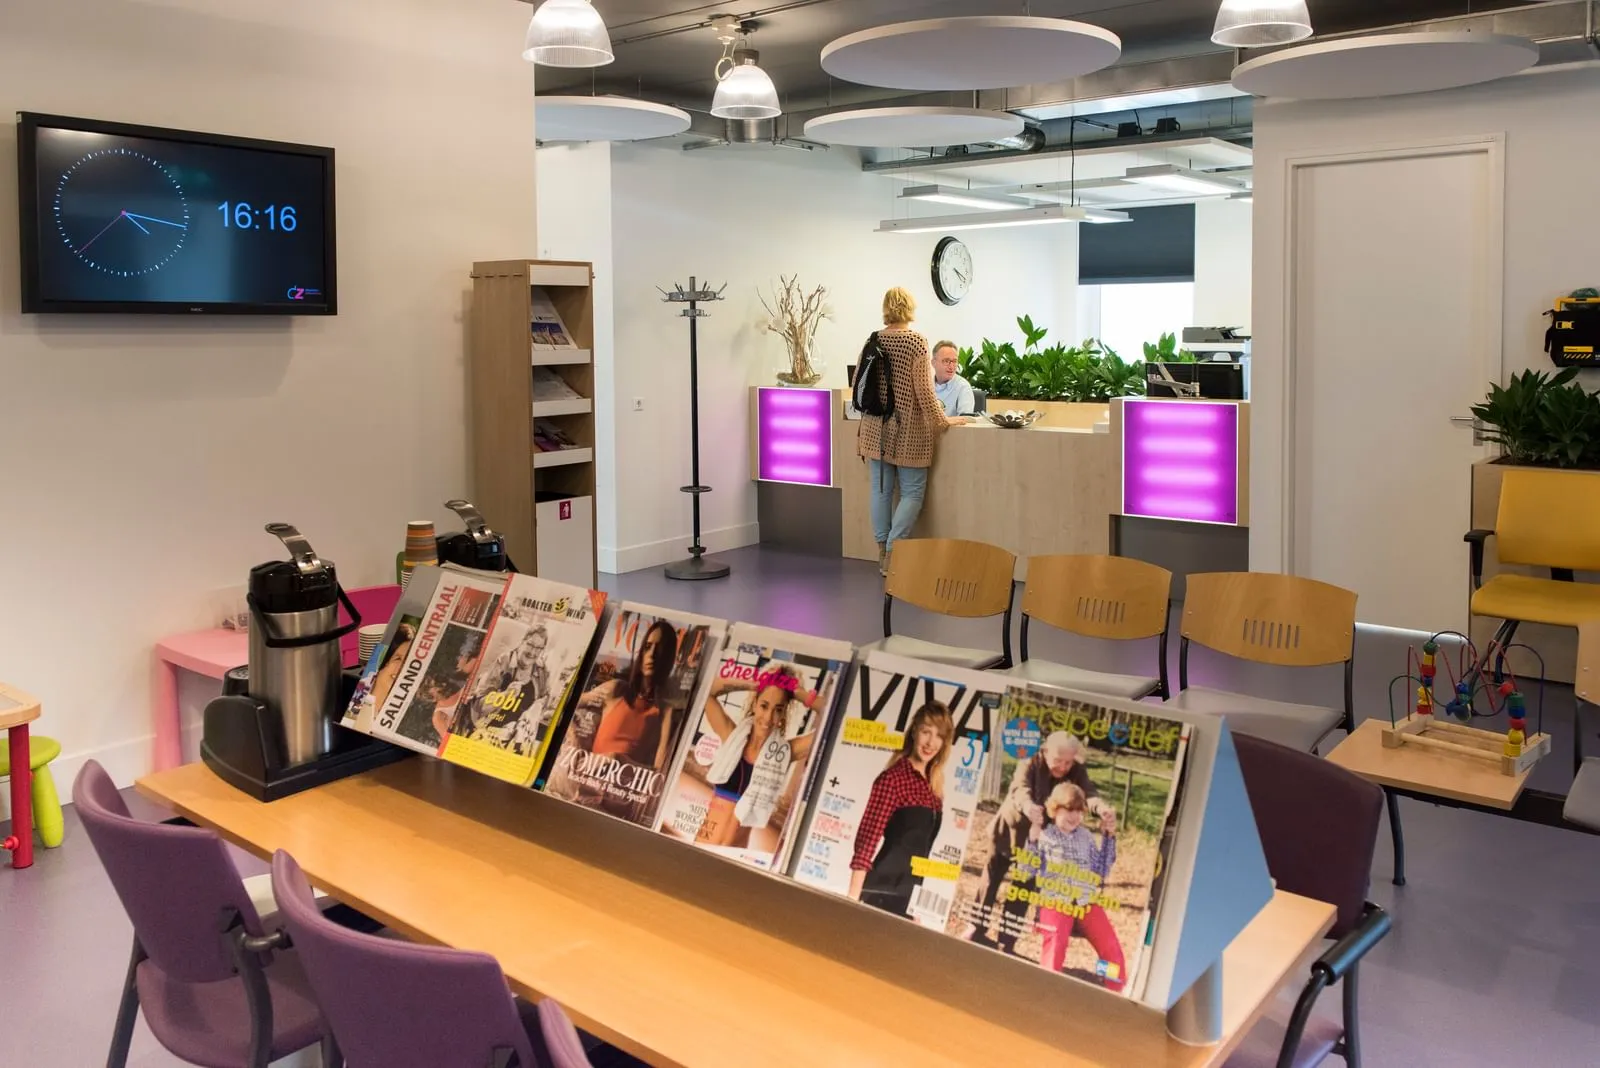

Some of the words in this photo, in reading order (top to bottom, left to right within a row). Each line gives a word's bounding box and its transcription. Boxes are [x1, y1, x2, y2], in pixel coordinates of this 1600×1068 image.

[217, 200, 298, 232] 16:16
[380, 584, 459, 729] SALLANDCENTRAAL
[484, 688, 525, 713] cobi
[764, 740, 789, 763] 96
[559, 745, 665, 798] ZOMERCHIC
